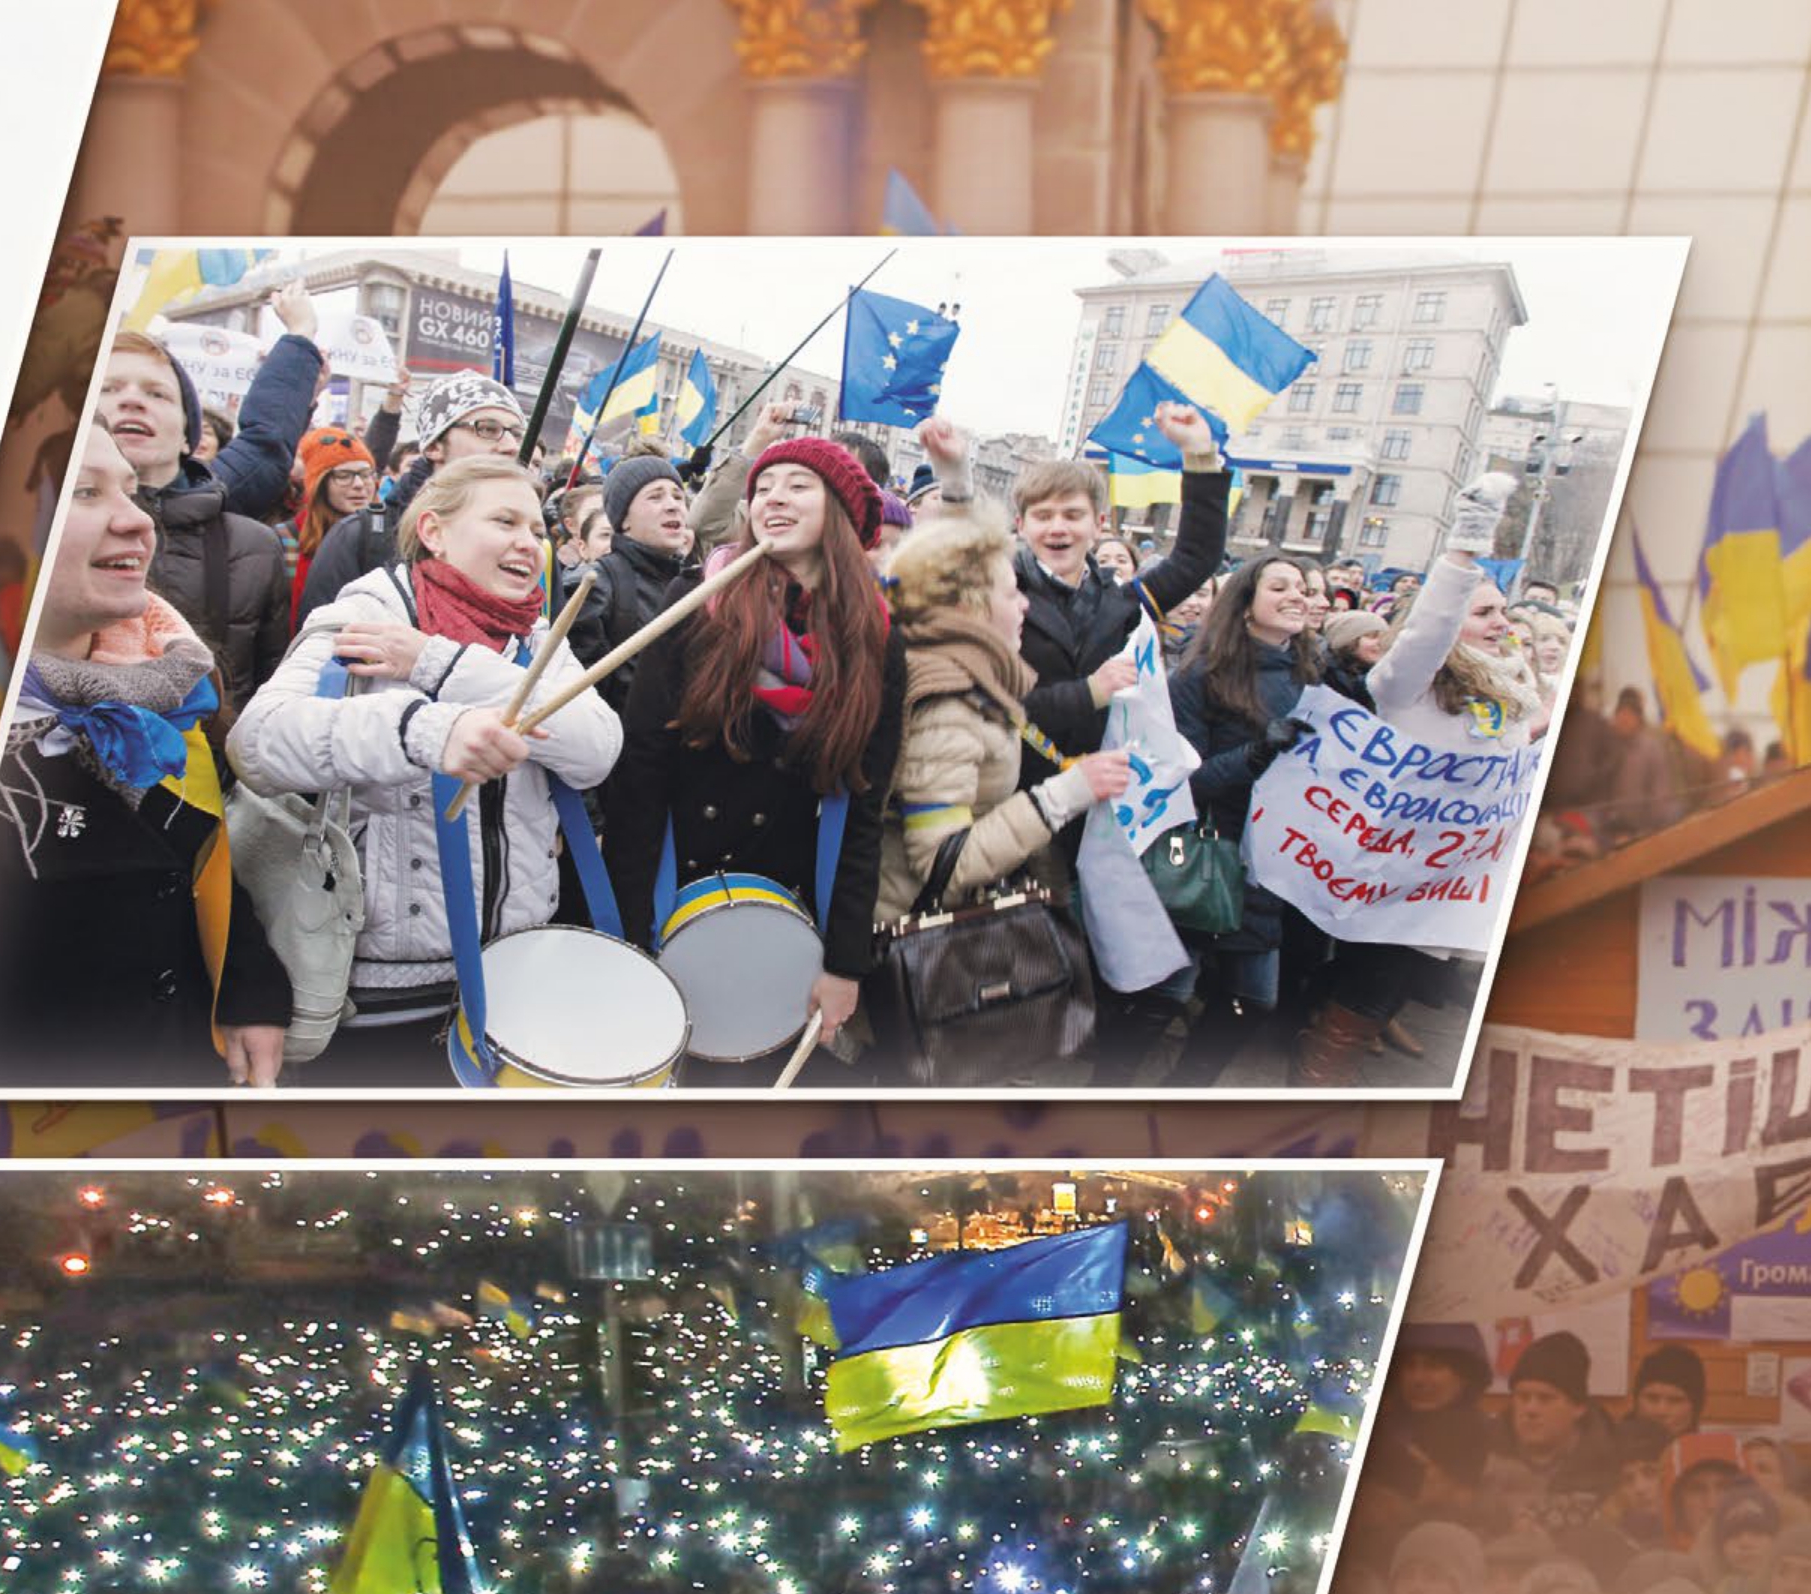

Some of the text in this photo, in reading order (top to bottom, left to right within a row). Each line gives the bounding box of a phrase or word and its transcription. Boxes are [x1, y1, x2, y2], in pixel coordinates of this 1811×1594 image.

[419, 298, 493, 329] НОВИЙ
[418, 316, 448, 340] GX
[452, 327, 490, 348] 460
